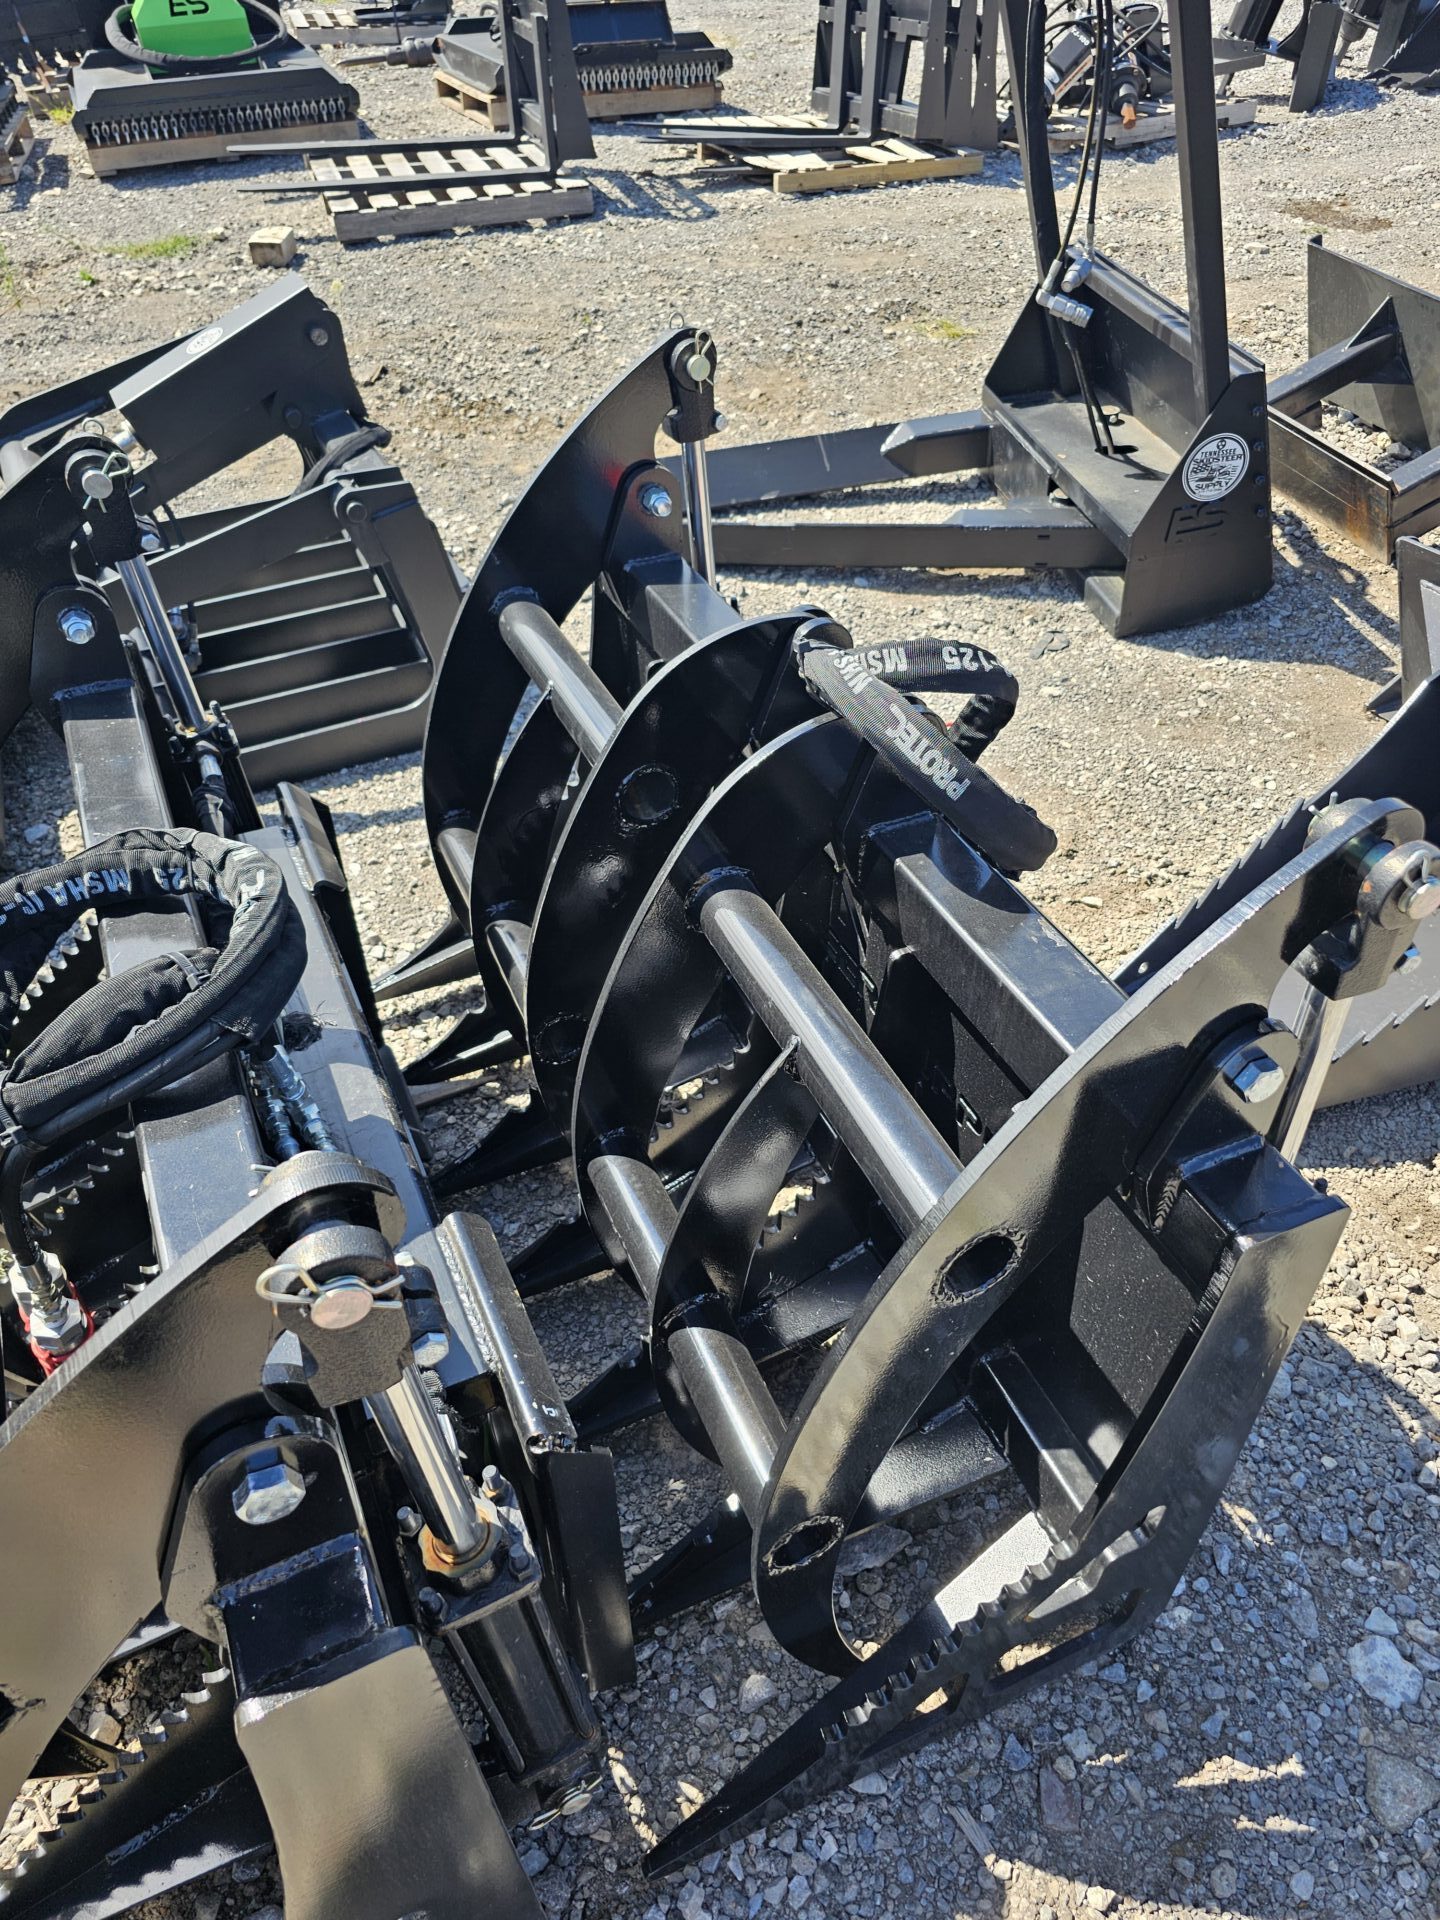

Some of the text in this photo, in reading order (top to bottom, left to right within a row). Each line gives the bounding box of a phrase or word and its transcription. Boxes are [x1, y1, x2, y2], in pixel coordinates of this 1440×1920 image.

[1201, 448, 1237, 458] TENNESSEE
[1193, 454, 1244, 465] SKIDSTEER
[1195, 481, 1230, 491] SUPPLY
[43, 868, 131, 907] MSHA
